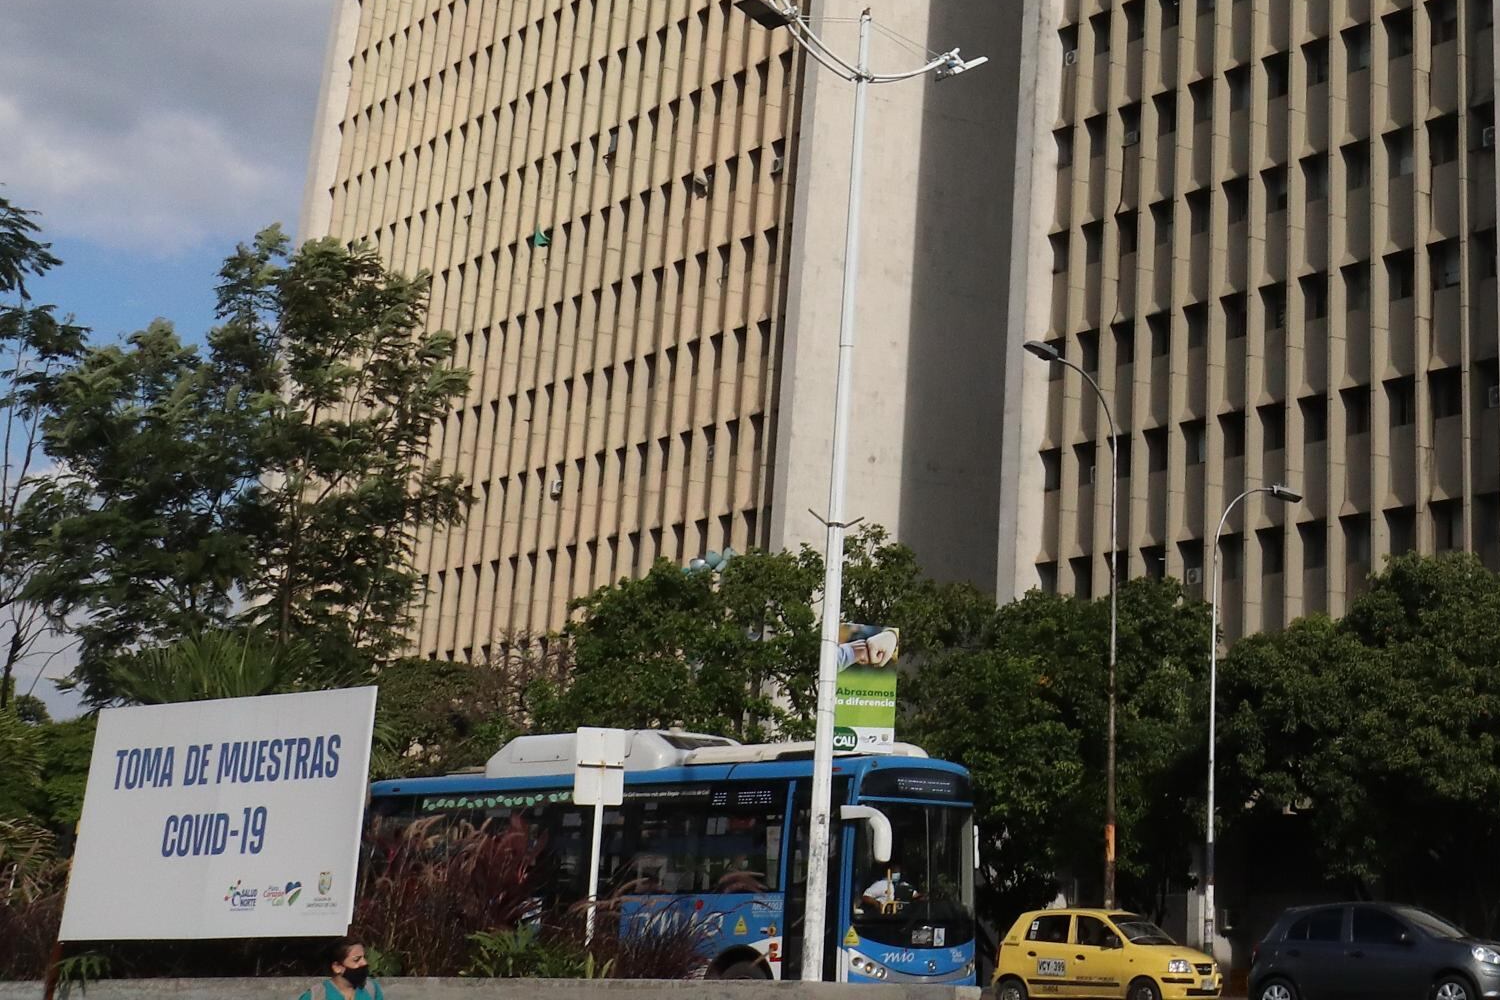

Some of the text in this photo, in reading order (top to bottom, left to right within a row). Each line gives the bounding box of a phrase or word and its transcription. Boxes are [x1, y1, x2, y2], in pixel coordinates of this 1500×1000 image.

[836, 687, 895, 697] Abrazamos
[846, 697, 895, 707] diferencia
[833, 735, 856, 747] CALI
[114, 734, 342, 790] TOMA DE MUESTRAS
[161, 806, 268, 857] COVID-19
[240, 898, 257, 907] NORTE
